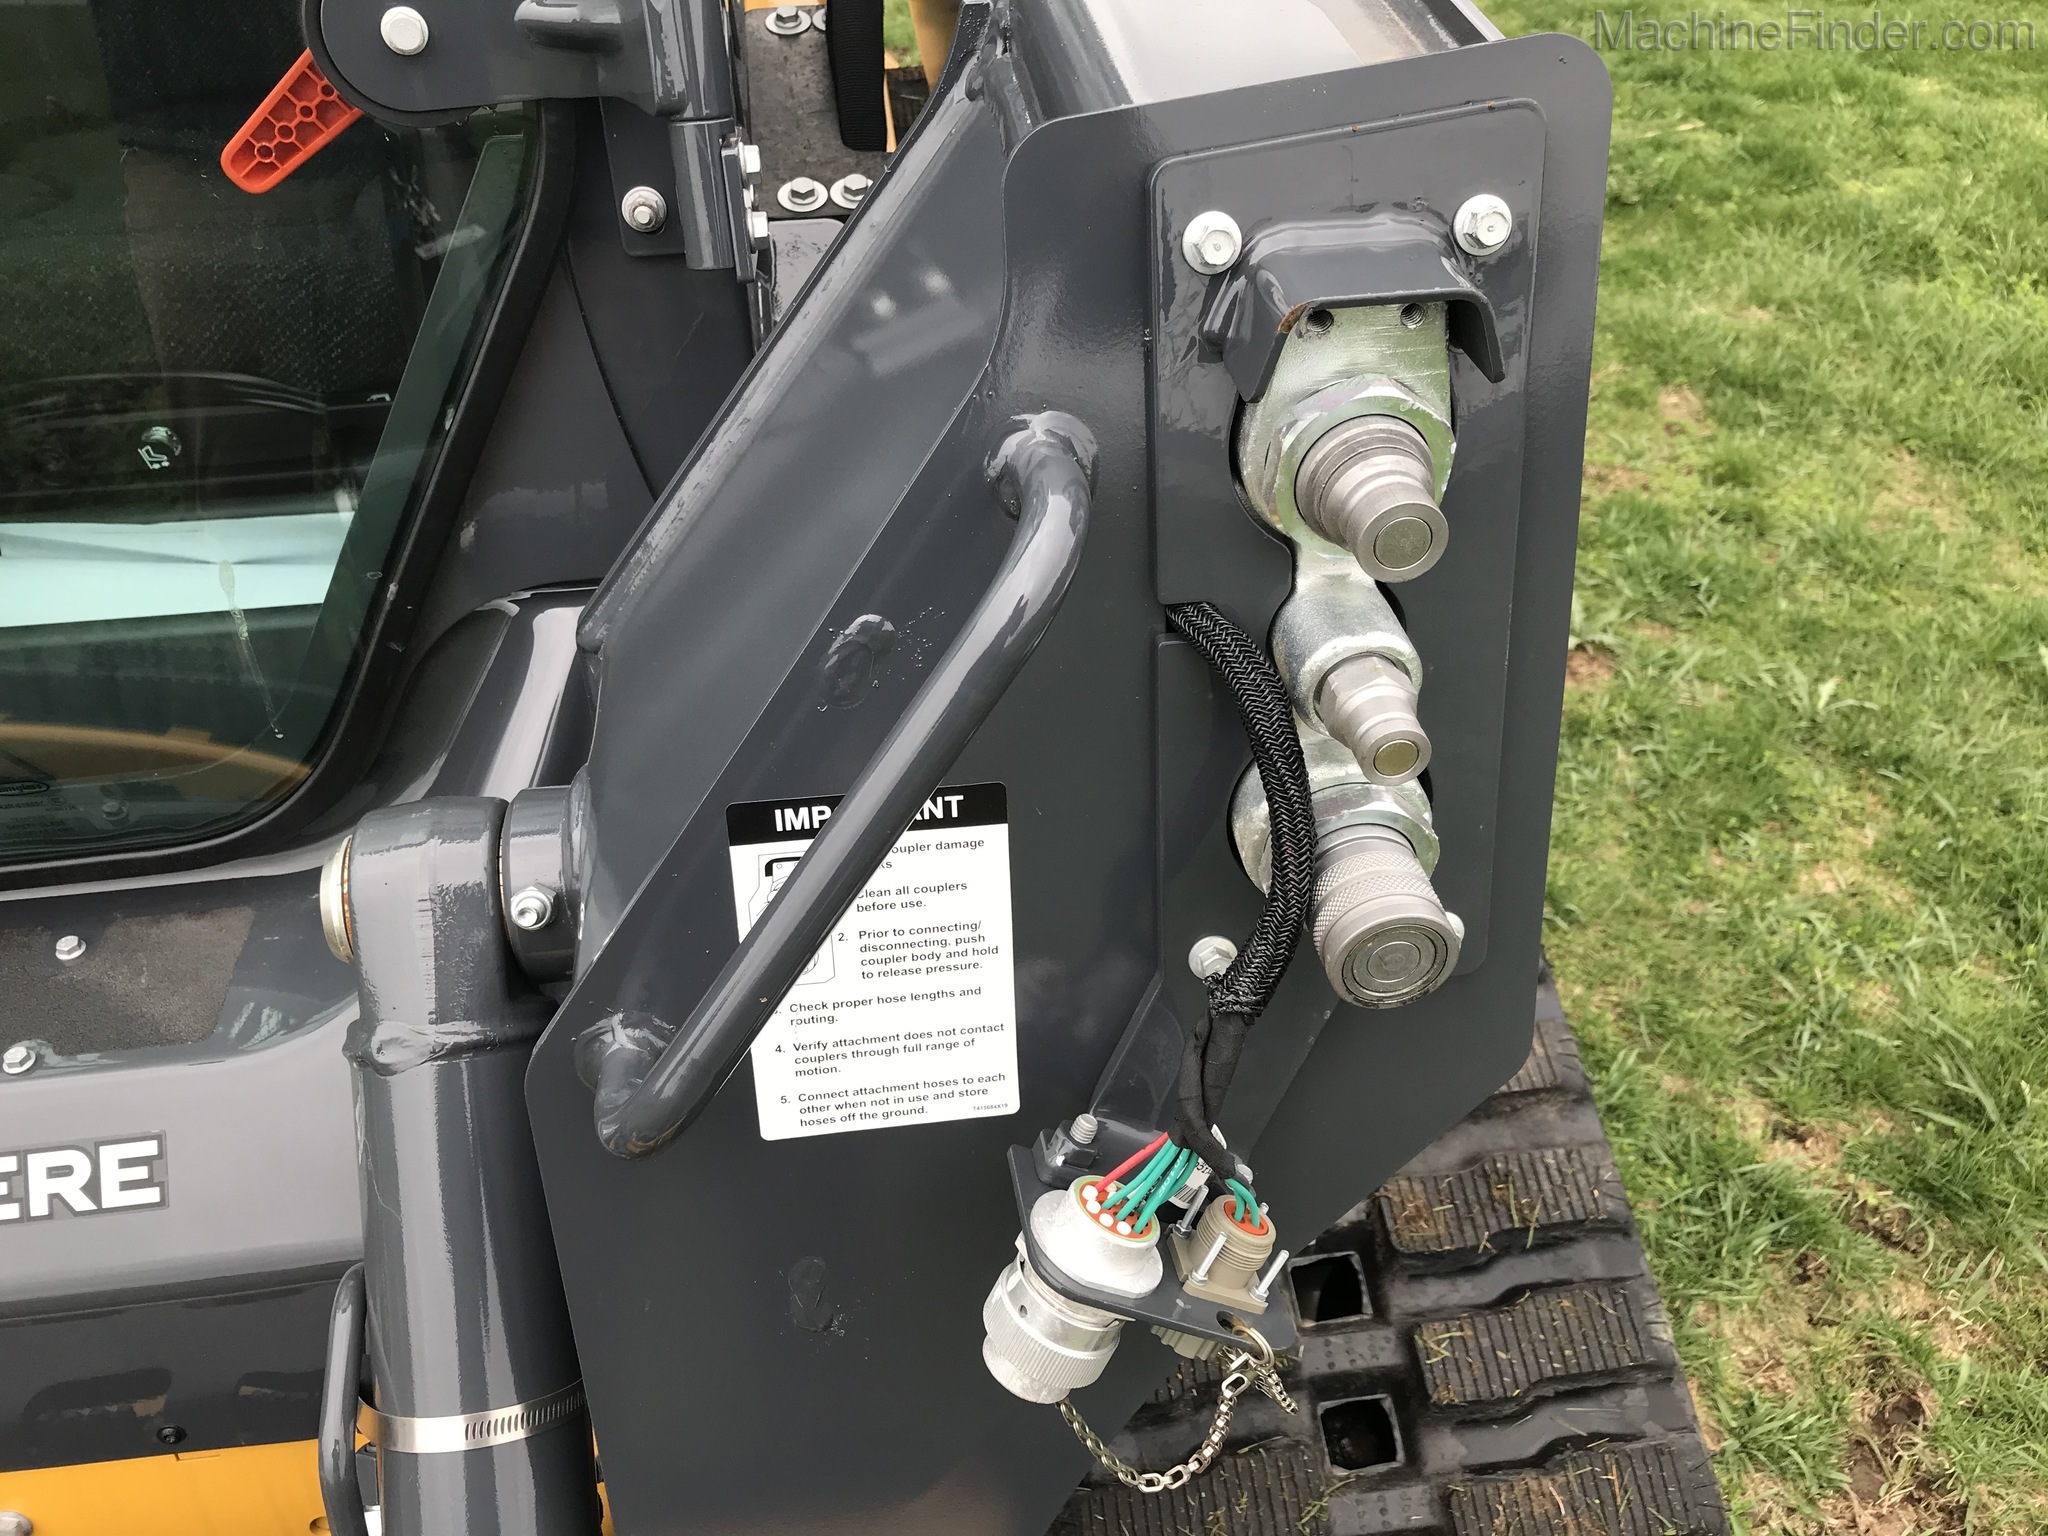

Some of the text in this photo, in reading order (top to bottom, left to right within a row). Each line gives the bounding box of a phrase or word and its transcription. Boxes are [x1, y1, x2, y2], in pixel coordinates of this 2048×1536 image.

[775, 795, 964, 832] IMPNT
[891, 840, 984, 855] oupler damage
[896, 886, 909, 895] all
[914, 883, 967, 894] couplers
[857, 902, 896, 912] before
[838, 933, 848, 941] 2.
[859, 930, 889, 939] Prior
[909, 921, 981, 935] connecting/
[860, 934, 985, 954] disconnecting, push
[861, 946, 998, 968] coupler body and hold
[862, 963, 982, 979] to release pressure.
[790, 987, 981, 1012] Check proper hose lengths and
[791, 1015, 838, 1027] routing.
[775, 1024, 1004, 1053] 4. Verify attachment does not contact
[795, 1038, 975, 1064] couplers through full range of
[796, 1067, 840, 1077] motion.
[781, 1096, 790, 1104] 5.
[799, 1090, 848, 1102] Connect
[853, 1082, 919, 1097] attachment
[924, 1079, 958, 1088] hoses
[978, 1073, 1005, 1083] each
[800, 1105, 830, 1114] other
[835, 1101, 866, 1110] when
[871, 1098, 889, 1106] not
[894, 1096, 904, 1104] in
[933, 1090, 954, 1100] and
[959, 1089, 988, 1097] store
[800, 1106, 927, 1126] hoses off the ground.
